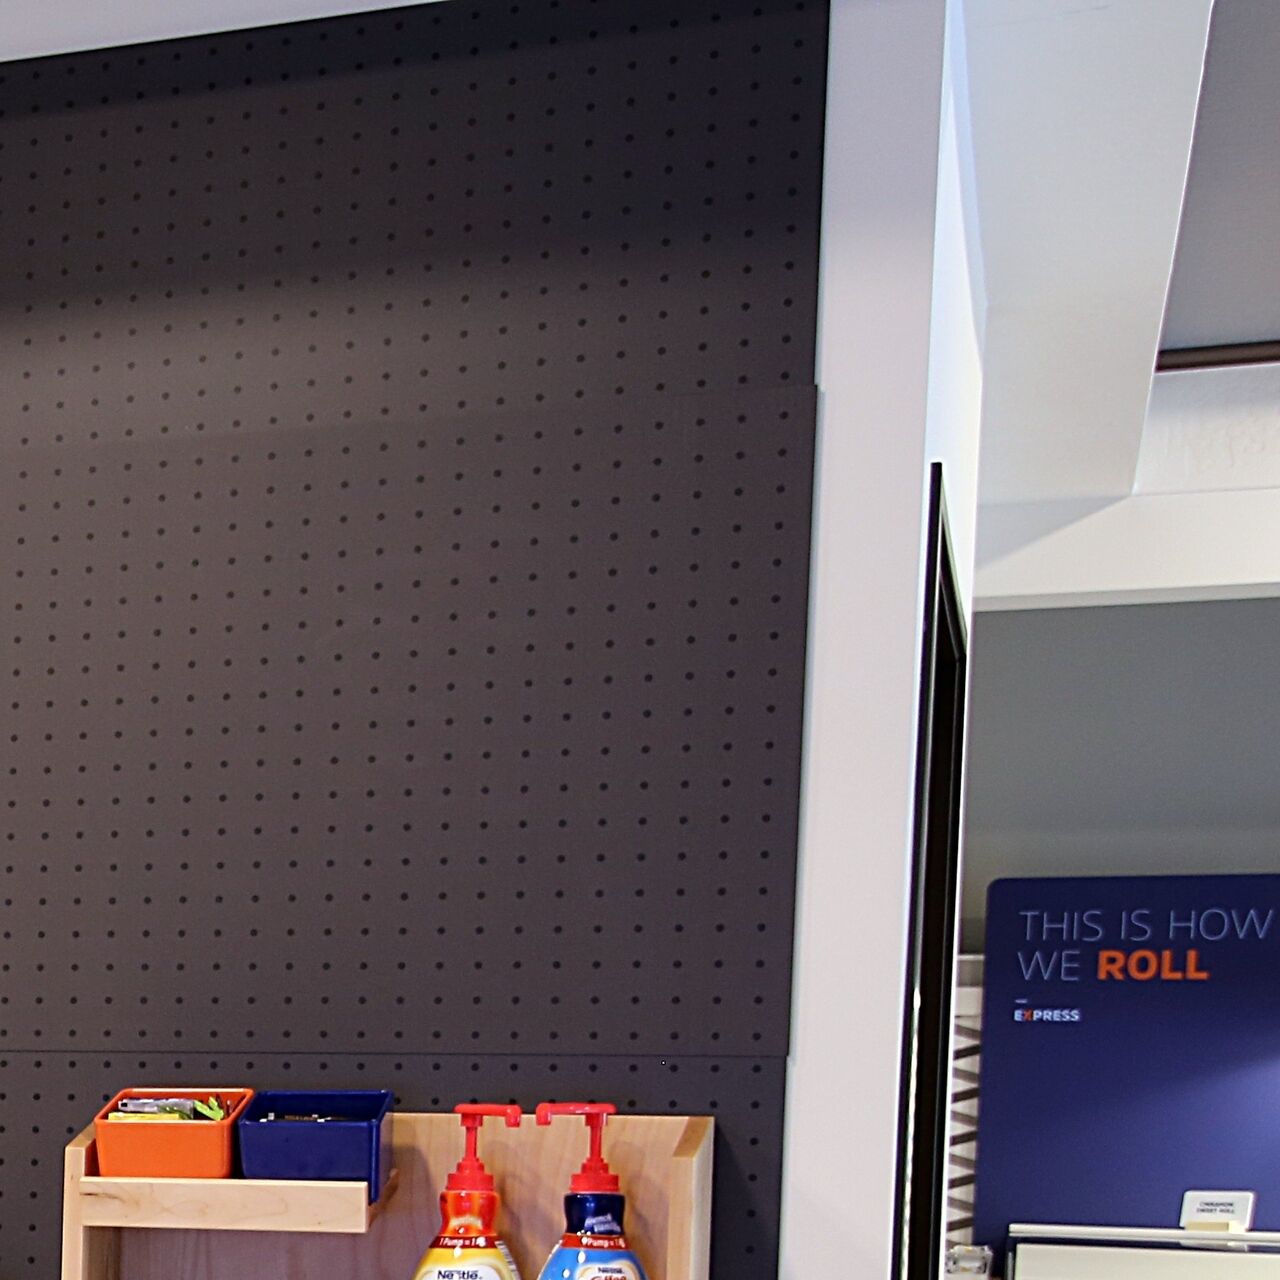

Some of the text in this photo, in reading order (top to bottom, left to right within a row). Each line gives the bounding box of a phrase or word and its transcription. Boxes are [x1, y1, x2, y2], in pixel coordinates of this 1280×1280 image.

[1019, 908, 1274, 942] THIS IS HOW
[1017, 949, 1210, 981] WE ROLL
[1013, 1009, 1081, 1022] EXPRESS
